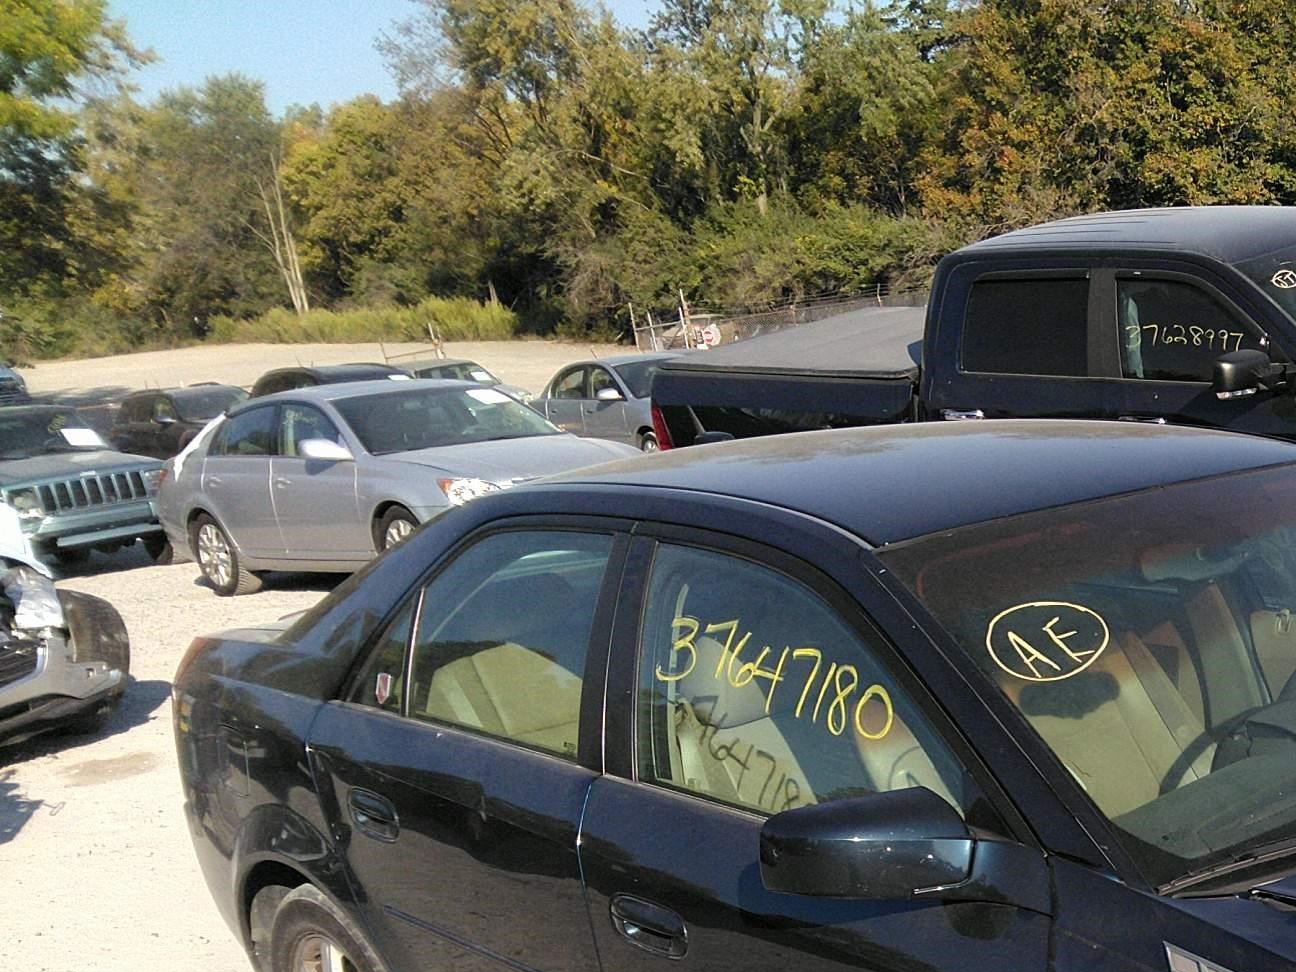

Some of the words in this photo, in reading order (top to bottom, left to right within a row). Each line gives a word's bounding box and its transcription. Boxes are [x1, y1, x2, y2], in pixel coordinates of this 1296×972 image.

[1124, 323, 1244, 353] 37628997
[655, 616, 894, 740] 37647180
[1007, 616, 1095, 678] AE
